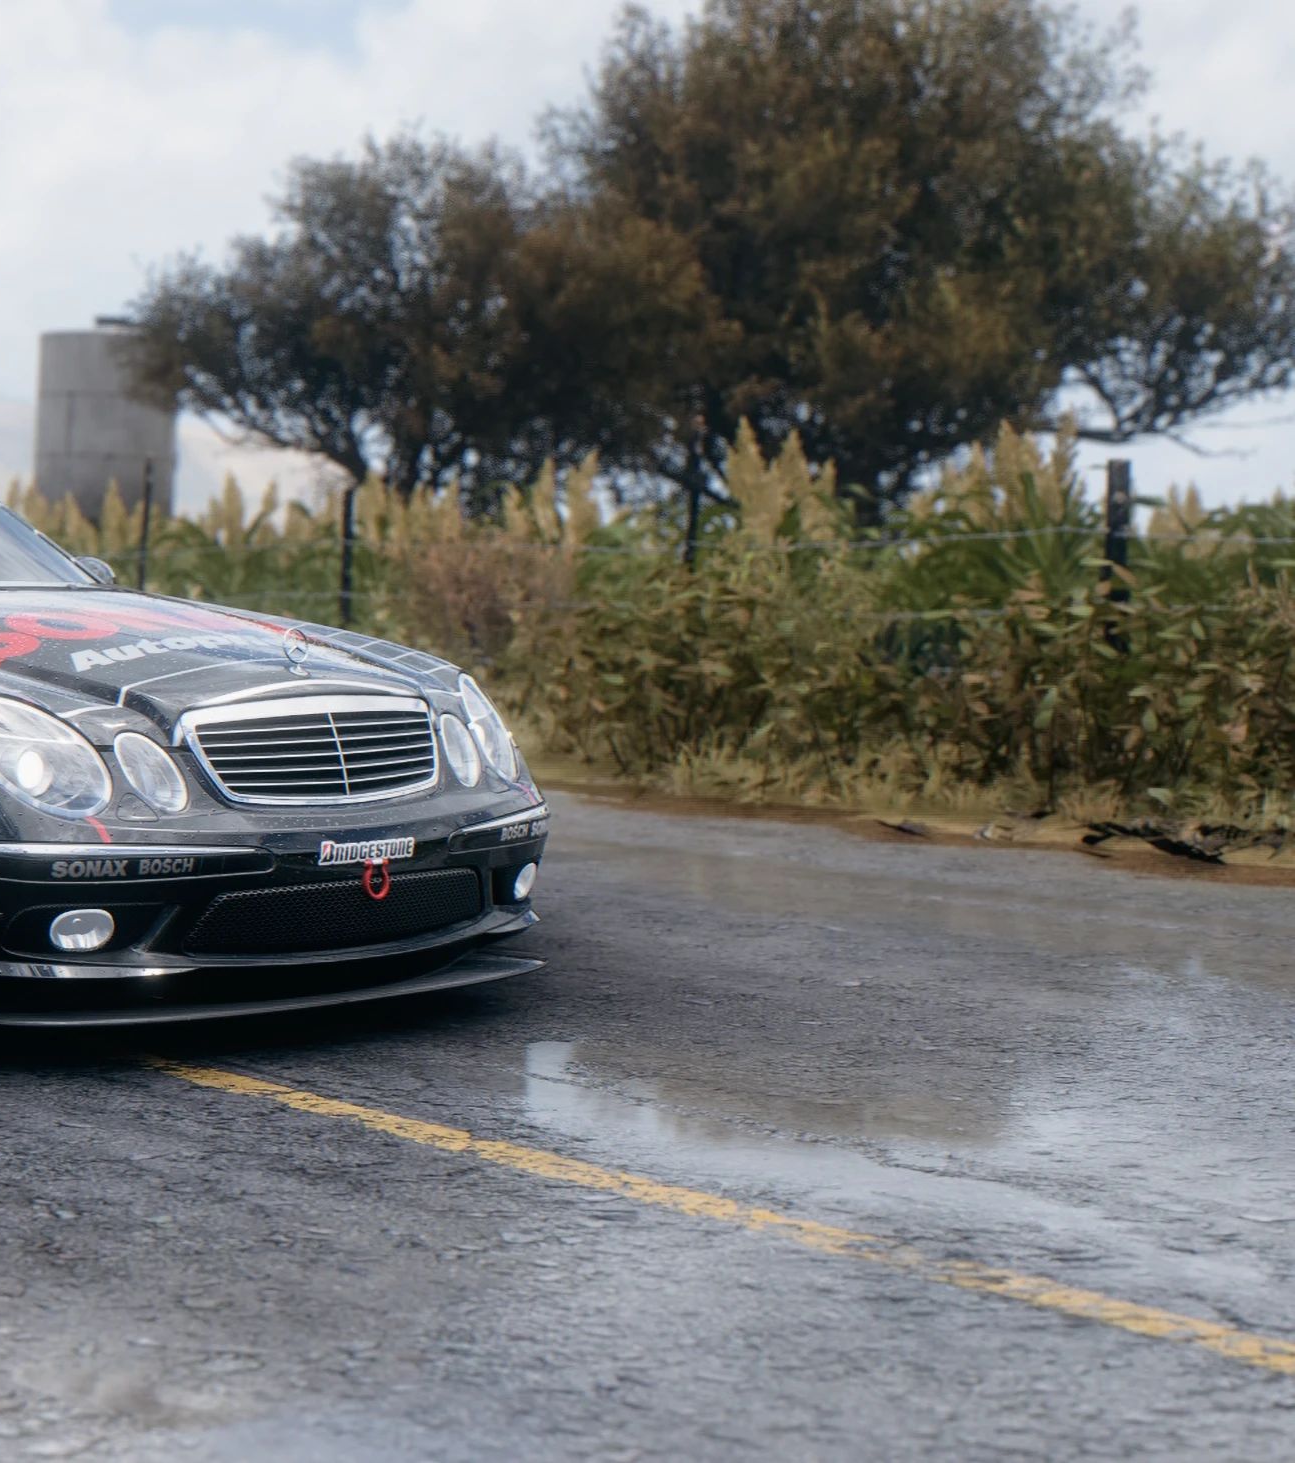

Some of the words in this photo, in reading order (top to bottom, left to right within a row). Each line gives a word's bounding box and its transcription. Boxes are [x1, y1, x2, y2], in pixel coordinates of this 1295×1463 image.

[319, 838, 415, 864] BRIDGESTONE
[51, 858, 130, 879] SONAX
[138, 858, 196, 876] BOSCH
